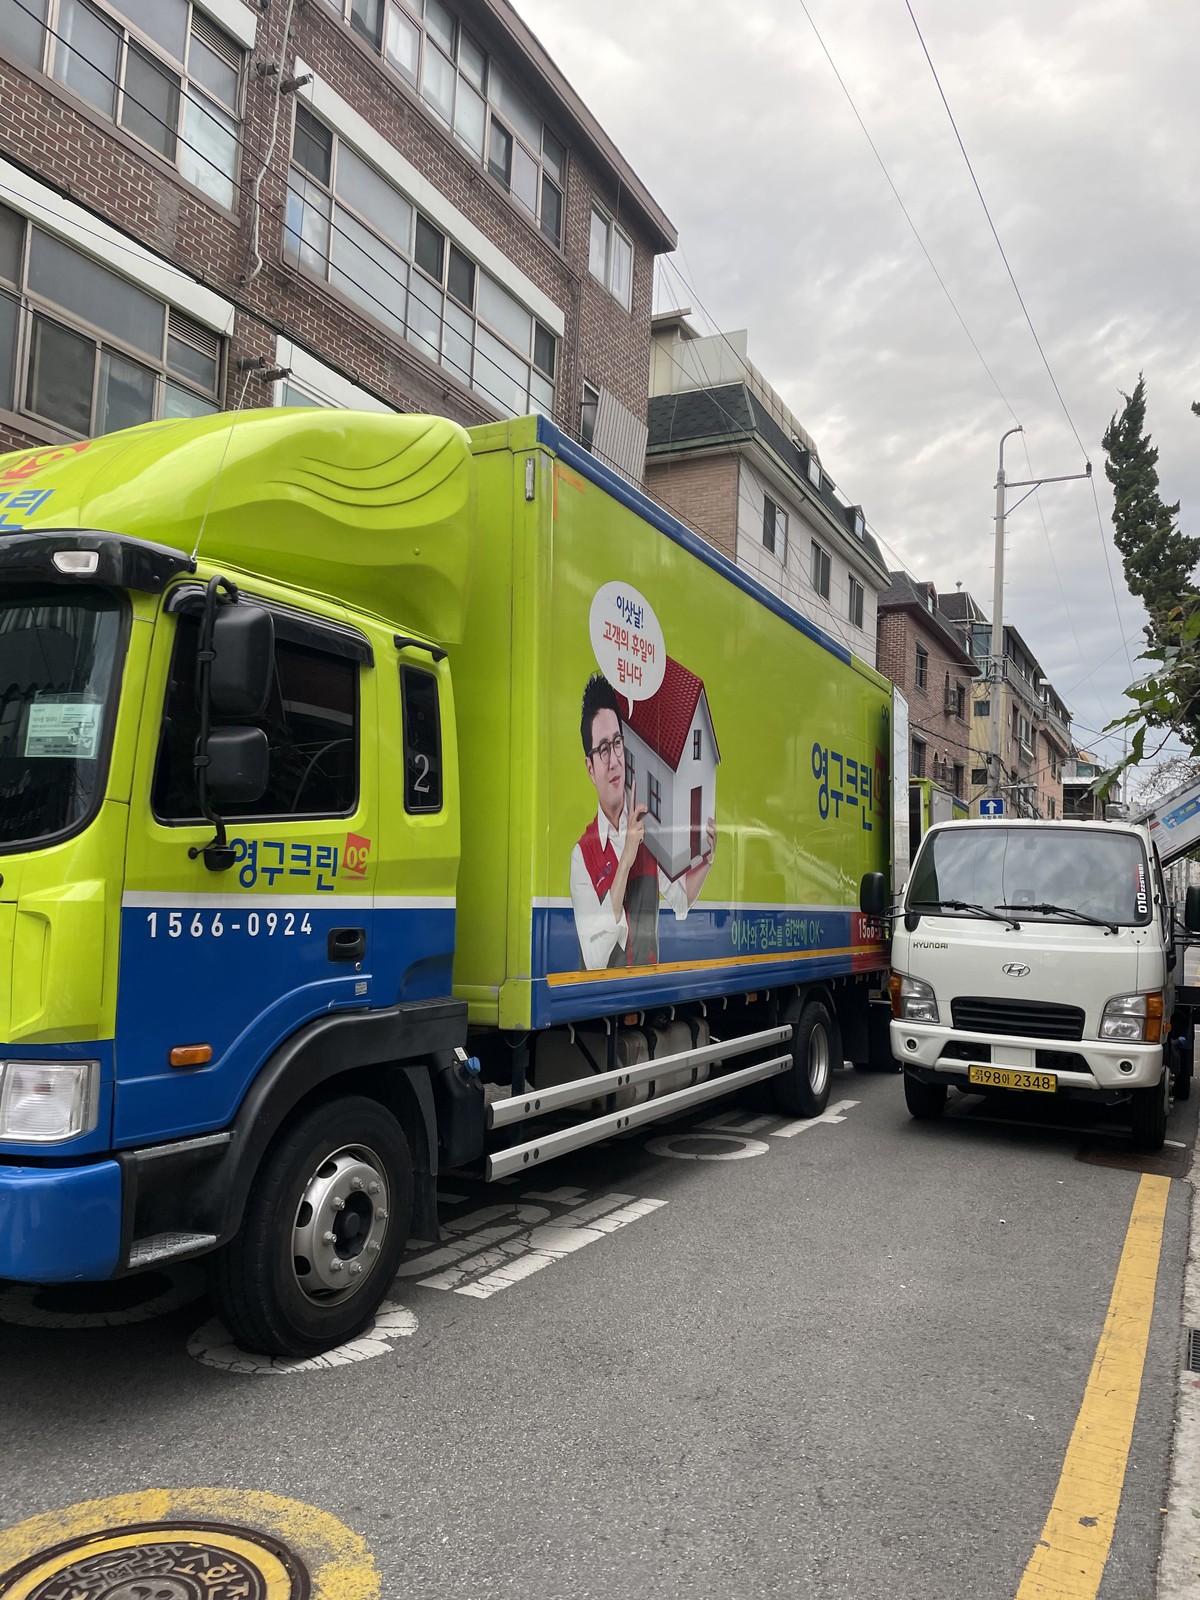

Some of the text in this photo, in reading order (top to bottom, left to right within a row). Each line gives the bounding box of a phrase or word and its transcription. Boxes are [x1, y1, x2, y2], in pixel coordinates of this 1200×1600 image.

[616, 595, 644, 629] 이삿날!
[603, 621, 655, 663] 고객의 휴일이
[616, 657, 643, 687] 됩니다
[413, 754, 431, 794] 2
[811, 742, 873, 832] 영구크린
[229, 837, 339, 891] 영구크린
[1136, 892, 1148, 914] 010
[146, 912, 313, 938] 1566-0924
[731, 918, 758, 951] 이사와
[759, 918, 783, 950] 청소를
[1013, 1074, 1051, 1090] 2348
